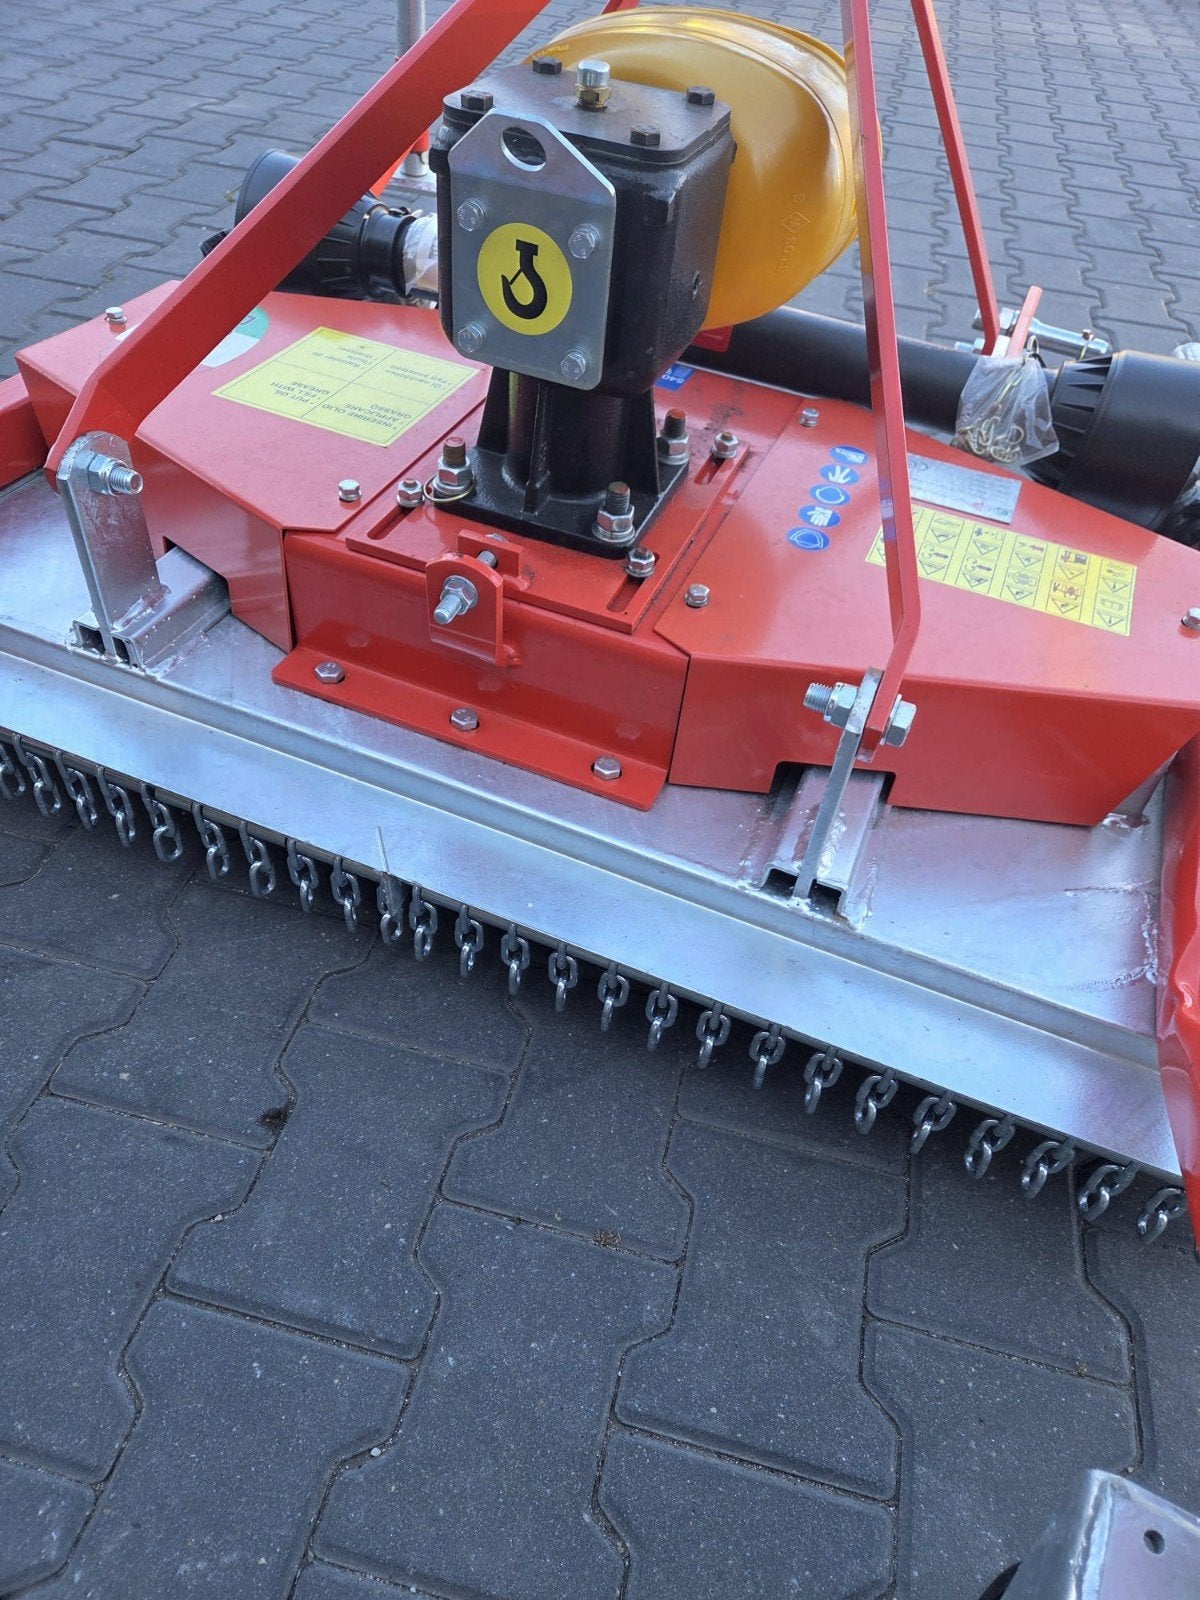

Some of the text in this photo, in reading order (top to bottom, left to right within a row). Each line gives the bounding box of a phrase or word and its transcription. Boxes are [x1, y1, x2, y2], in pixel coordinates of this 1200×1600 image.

[661, 374, 685, 384] 540
[270, 381, 318, 397] FILL WITH
[290, 380, 330, 394] GREASE
[273, 388, 310, 402] PUT OIL
[321, 404, 393, 427] INSERIRE OLIO
[344, 403, 400, 422] APPLICARE
[370, 404, 412, 418] GRASSO
